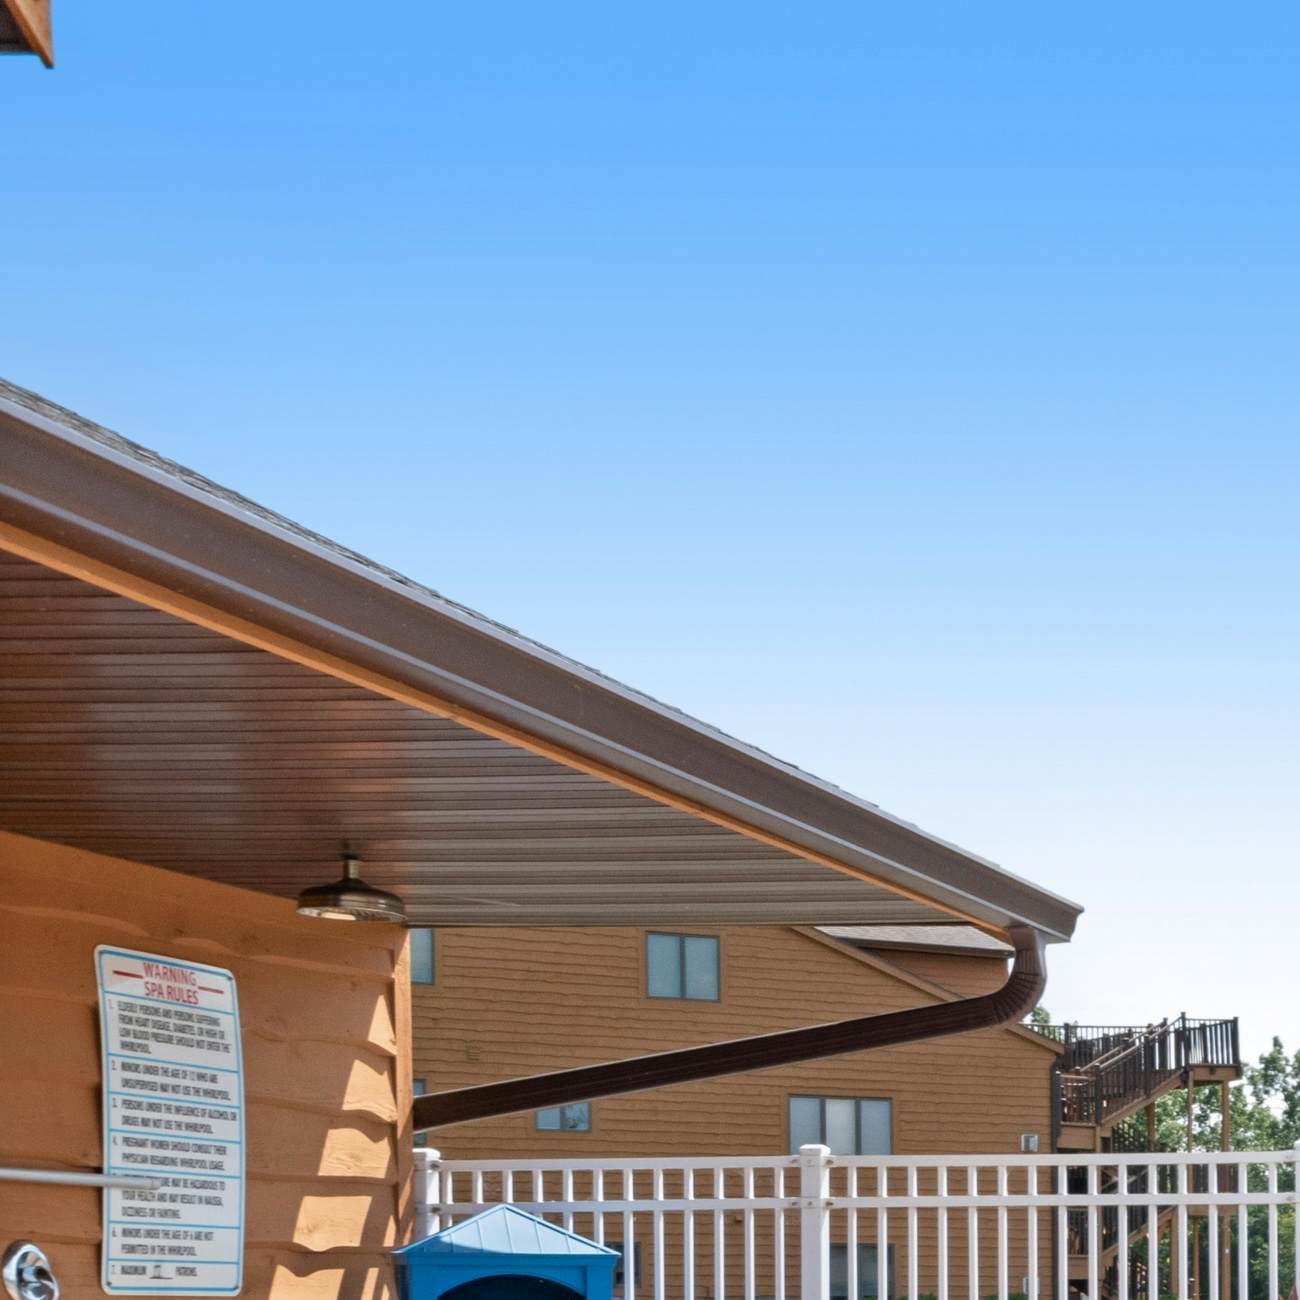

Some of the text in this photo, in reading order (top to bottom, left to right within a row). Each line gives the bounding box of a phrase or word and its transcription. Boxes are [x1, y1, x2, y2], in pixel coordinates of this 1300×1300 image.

[144, 962, 196, 986] WARNING
[144, 981, 199, 1005] SPA RULES
